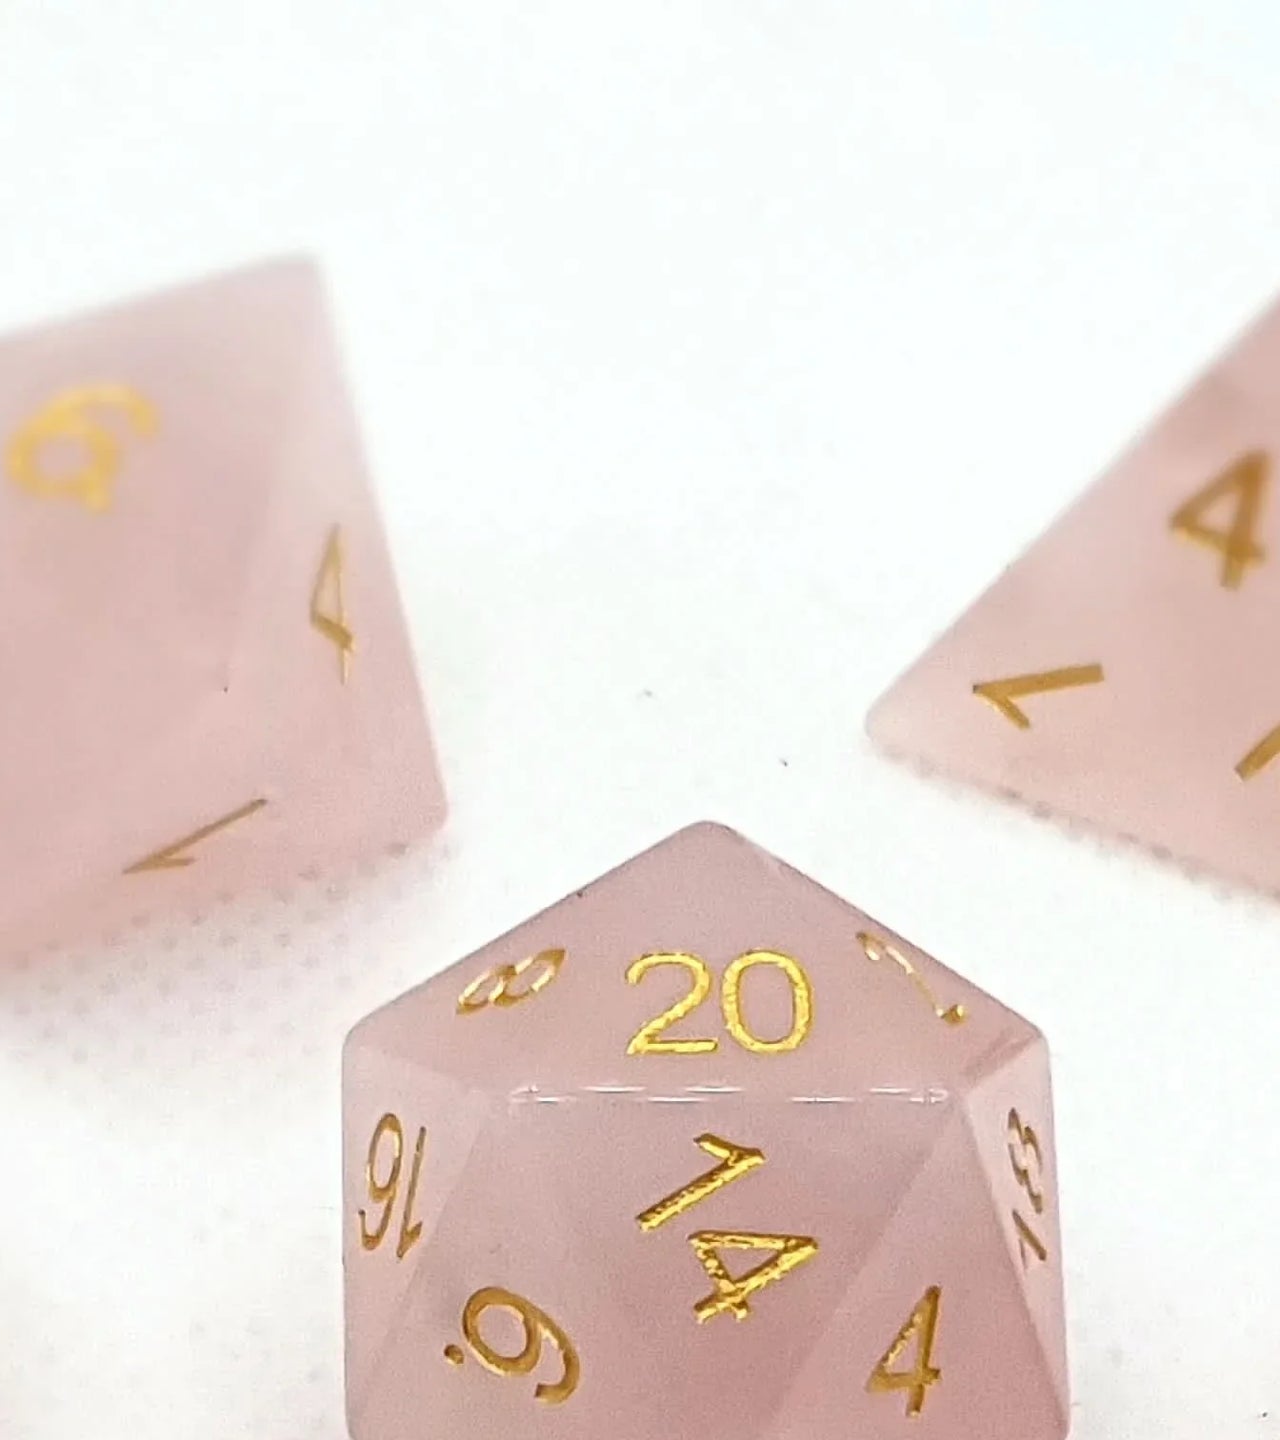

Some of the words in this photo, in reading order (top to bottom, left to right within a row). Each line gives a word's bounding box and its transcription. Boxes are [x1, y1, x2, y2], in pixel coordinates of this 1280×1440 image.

[1168, 450, 1272, 592] 4
[309, 523, 355, 685] 4
[972, 662, 1106, 730] 1
[123, 796, 269, 874] 1
[455, 948, 567, 1015] 8
[625, 949, 815, 1057] 20
[358, 1113, 426, 1262] 16
[635, 1132, 820, 1323] 14
[865, 1285, 942, 1418] 4
